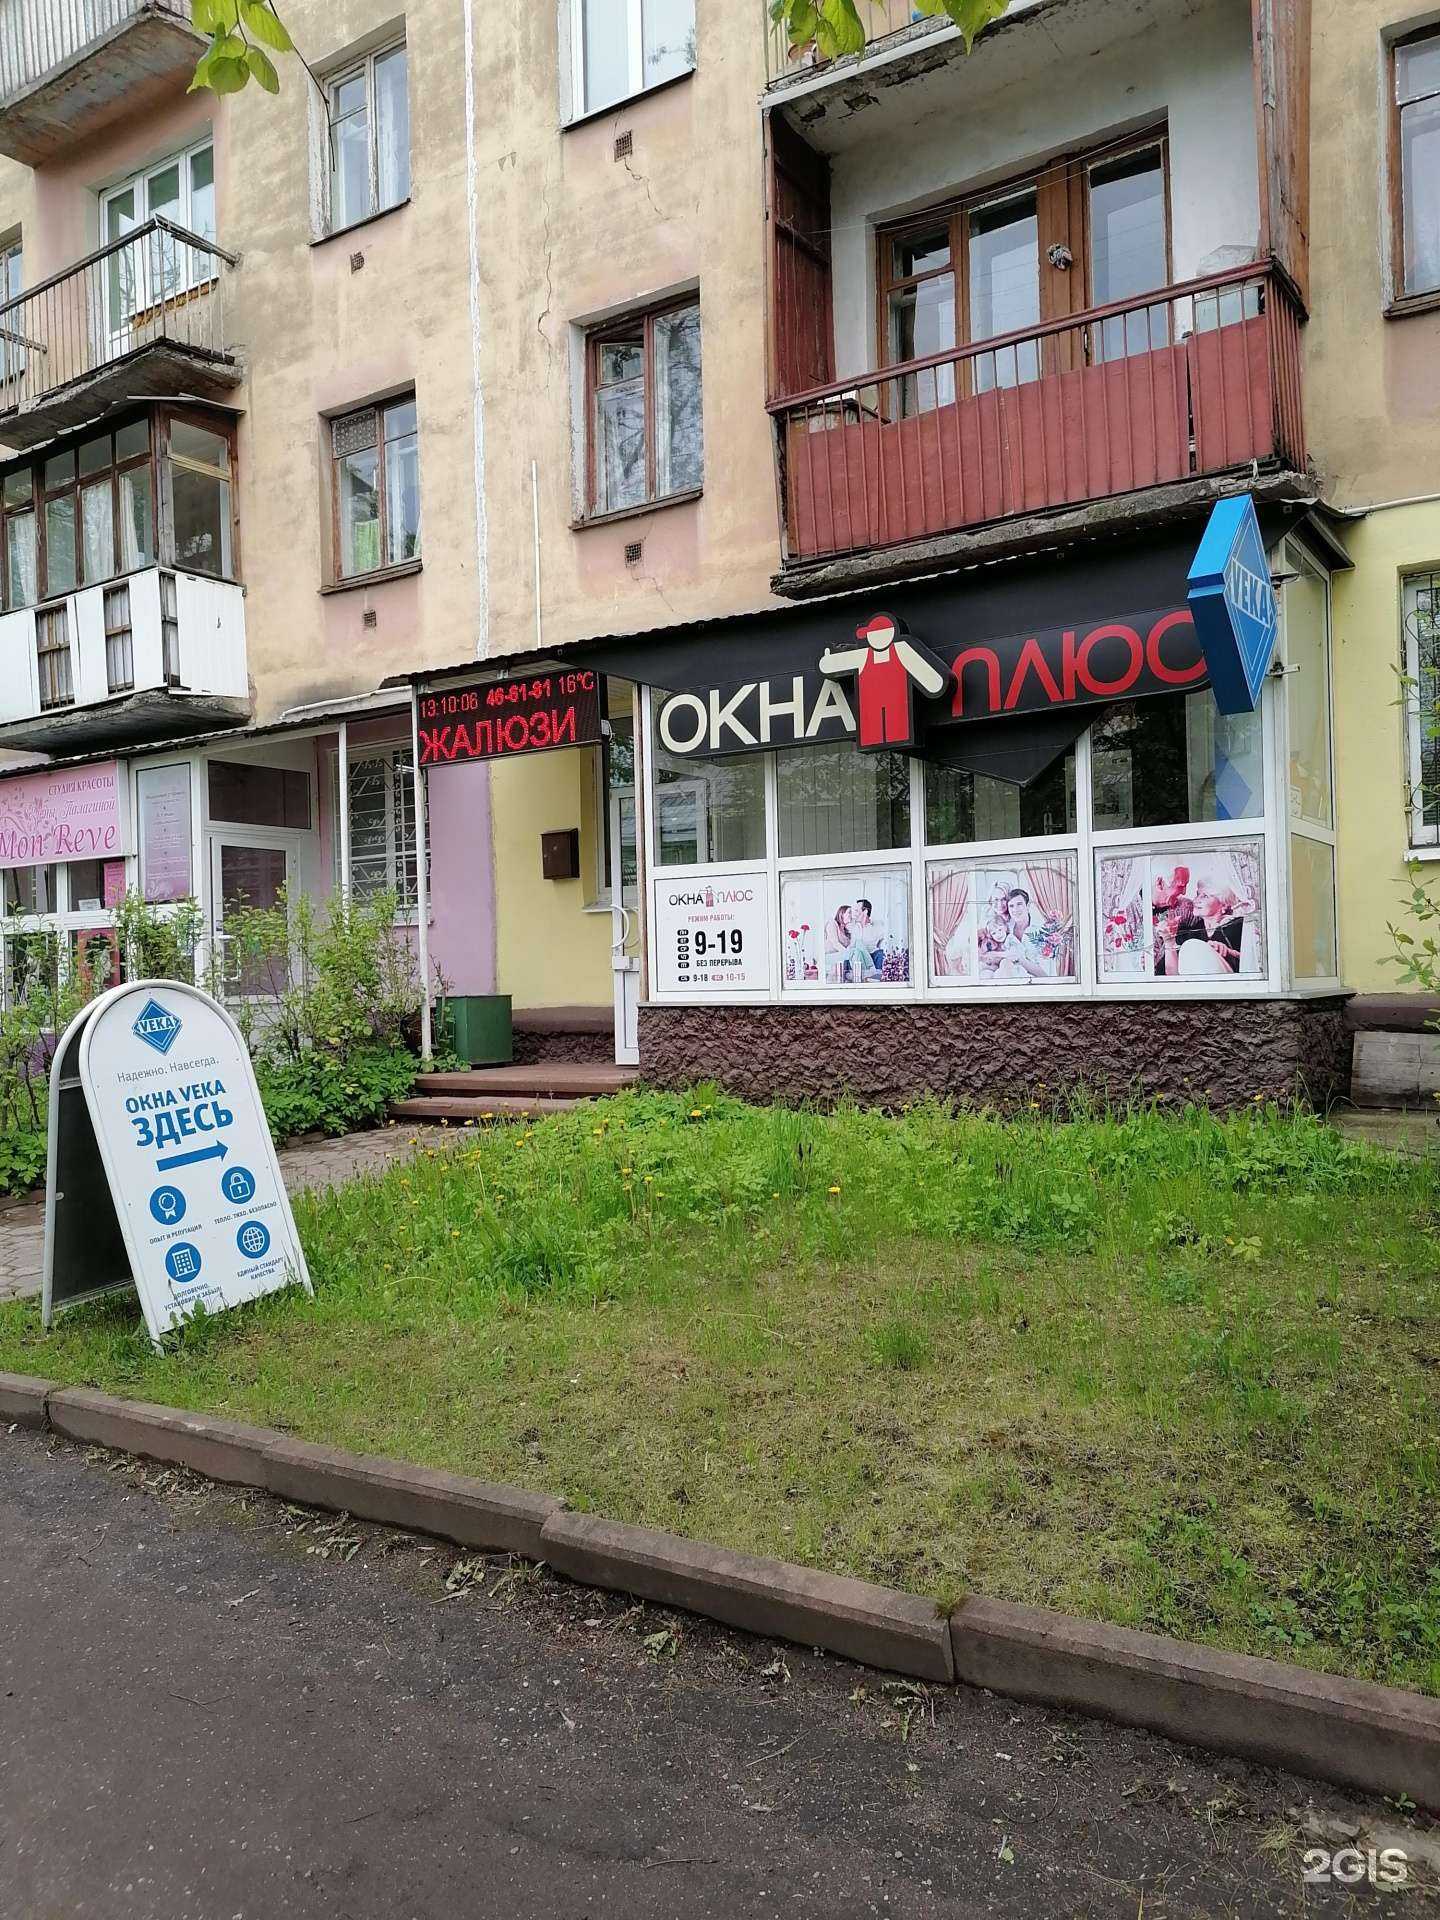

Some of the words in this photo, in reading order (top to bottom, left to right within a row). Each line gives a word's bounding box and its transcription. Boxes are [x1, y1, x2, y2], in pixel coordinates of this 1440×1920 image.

[1231, 561, 1273, 625] VEKA
[660, 676, 857, 753] ОКНА
[952, 609, 1207, 717] ПЛЮС
[419, 706, 576, 764] ЖАЛЮЗИ
[48, 782, 76, 796] СТУДИЯ
[77, 776, 114, 792] КРАСОТЫ
[53, 824, 116, 855] Reve
[669, 893, 704, 906] ОКНА
[717, 890, 753, 903] ПЛЮС
[710, 914, 735, 922] РАБОТЫ:
[695, 929, 743, 955] 9-19
[696, 959, 707, 967] БЕЗ
[709, 959, 743, 967] ПЕРЕРЫВА
[693, 973, 708, 981] 9-18
[138, 1018, 175, 1033] VEKA
[117, 1066, 168, 1083] Надежно.
[169, 1056, 220, 1074] Навсегда.
[125, 1089, 178, 1114] ОКНА
[178, 1079, 227, 1101] VEKA
[131, 1101, 234, 1149] ЗДЕСЬ
[149, 1235, 167, 1245] ОПЫТ
[171, 1224, 203, 1239] РЕПУТАЦИЯ
